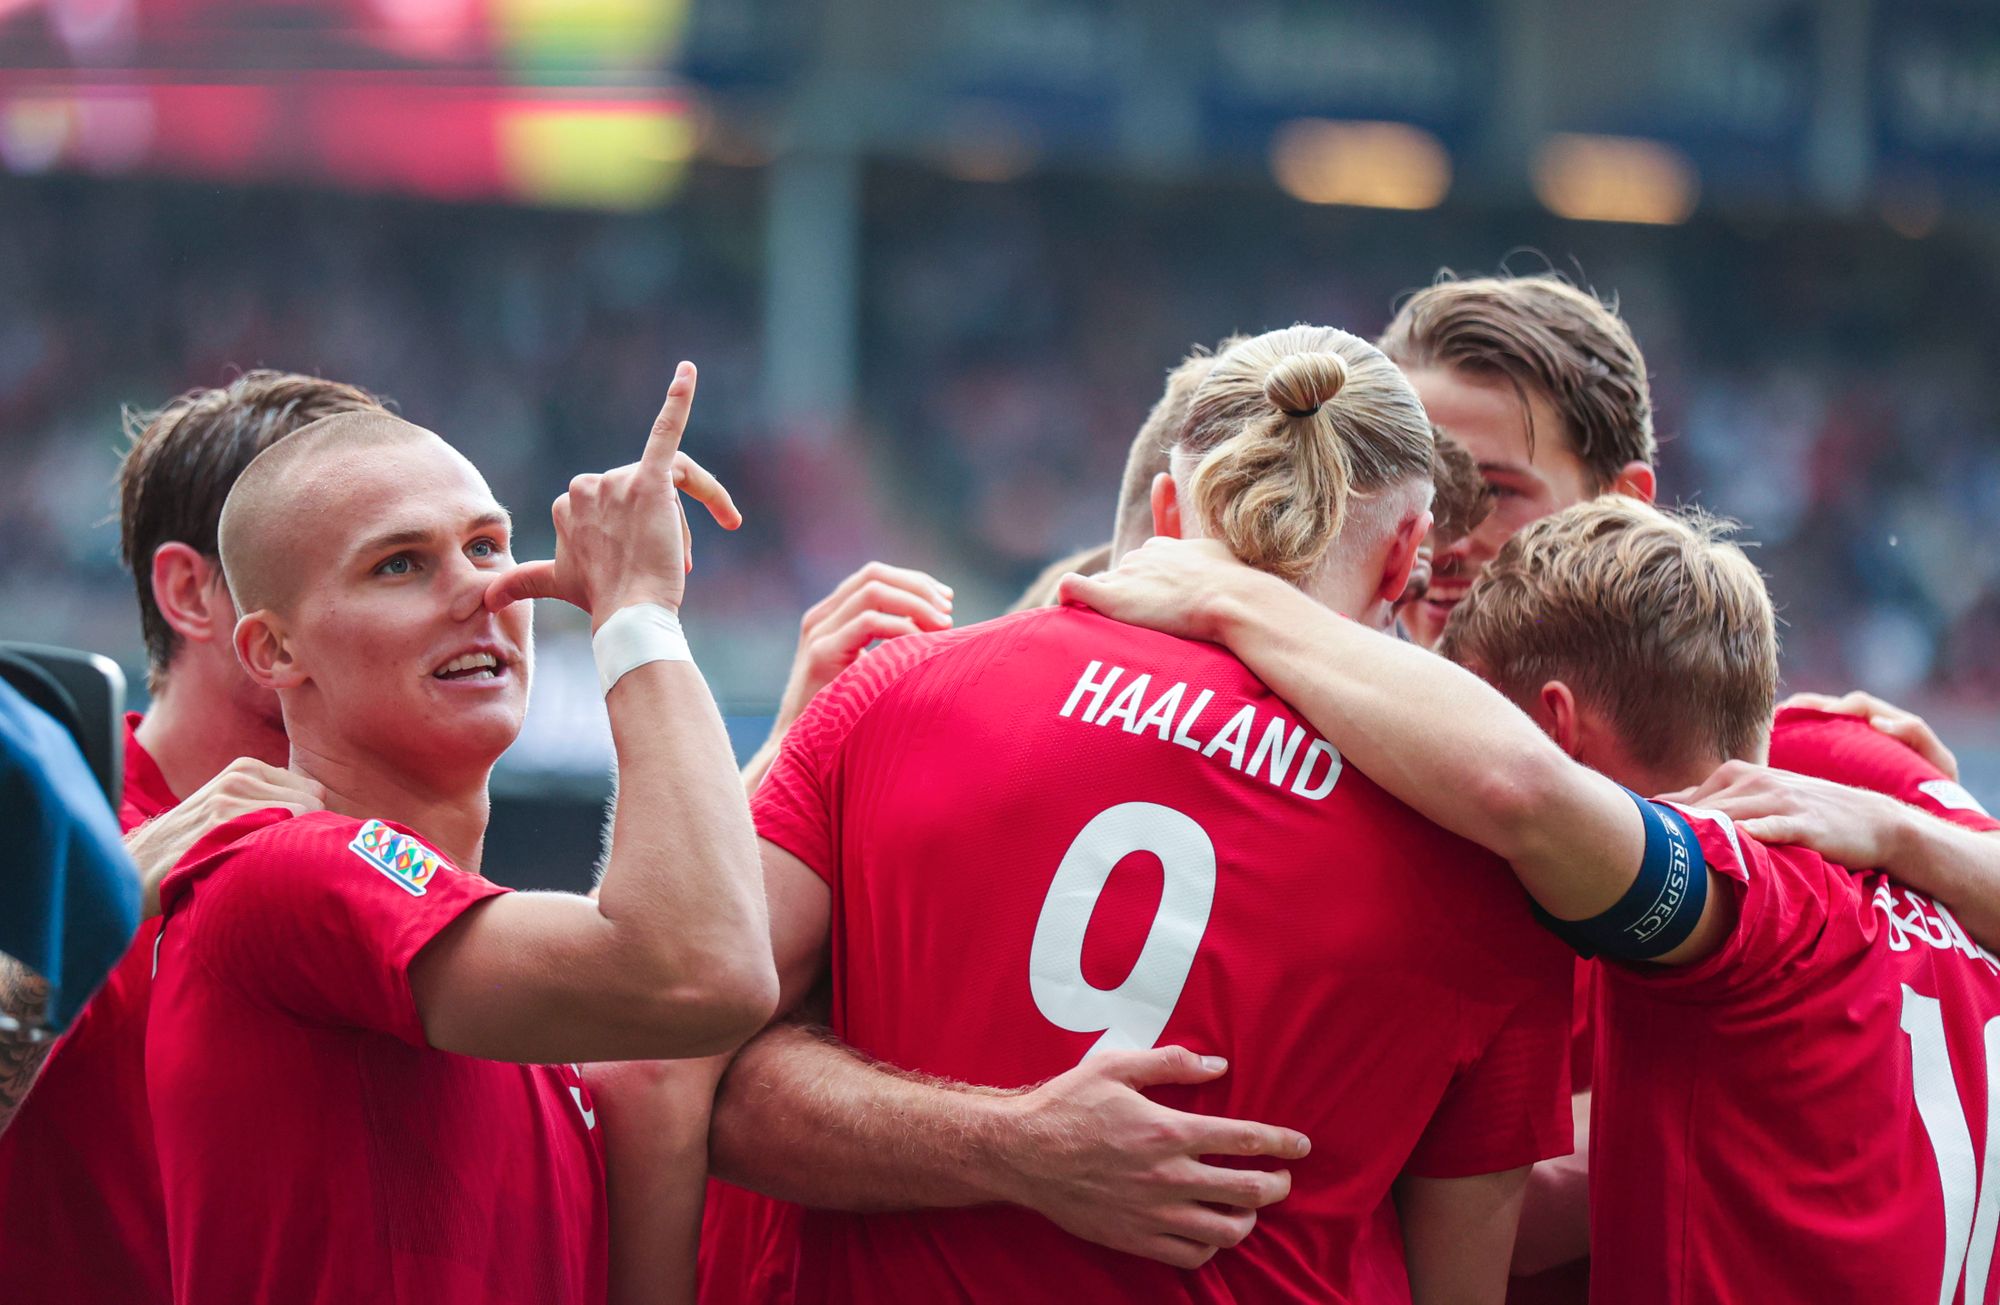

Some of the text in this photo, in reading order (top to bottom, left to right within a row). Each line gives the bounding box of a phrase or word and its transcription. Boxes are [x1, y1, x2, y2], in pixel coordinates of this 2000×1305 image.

[1059, 660, 1343, 800] HAALAND
[1029, 801, 1217, 1066] 9
[1633, 841, 1687, 940] RESPECT
